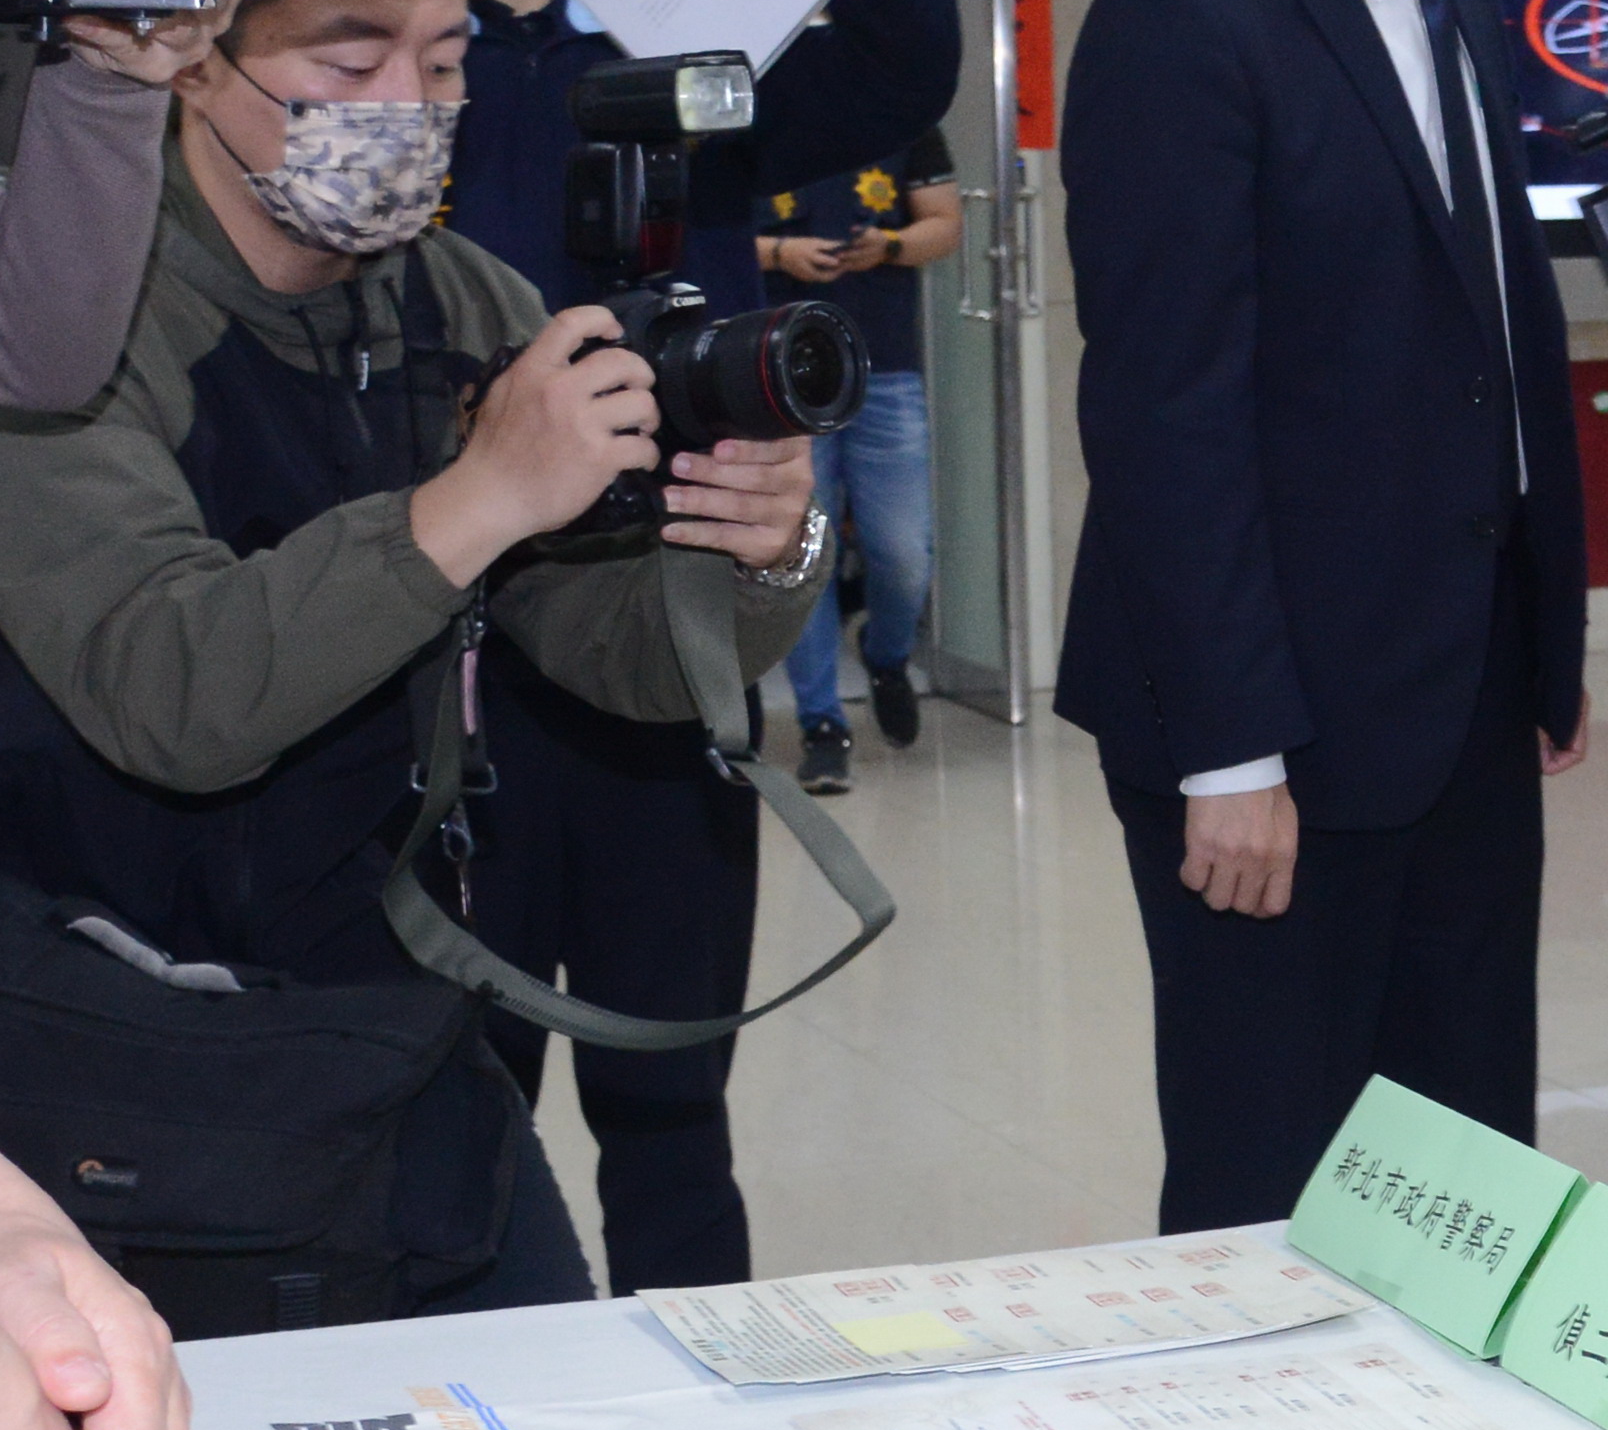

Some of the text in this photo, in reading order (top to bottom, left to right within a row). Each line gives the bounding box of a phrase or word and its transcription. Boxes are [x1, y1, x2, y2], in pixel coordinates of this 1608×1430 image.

[1329, 1140, 1517, 1275] 新北市政府警察局
